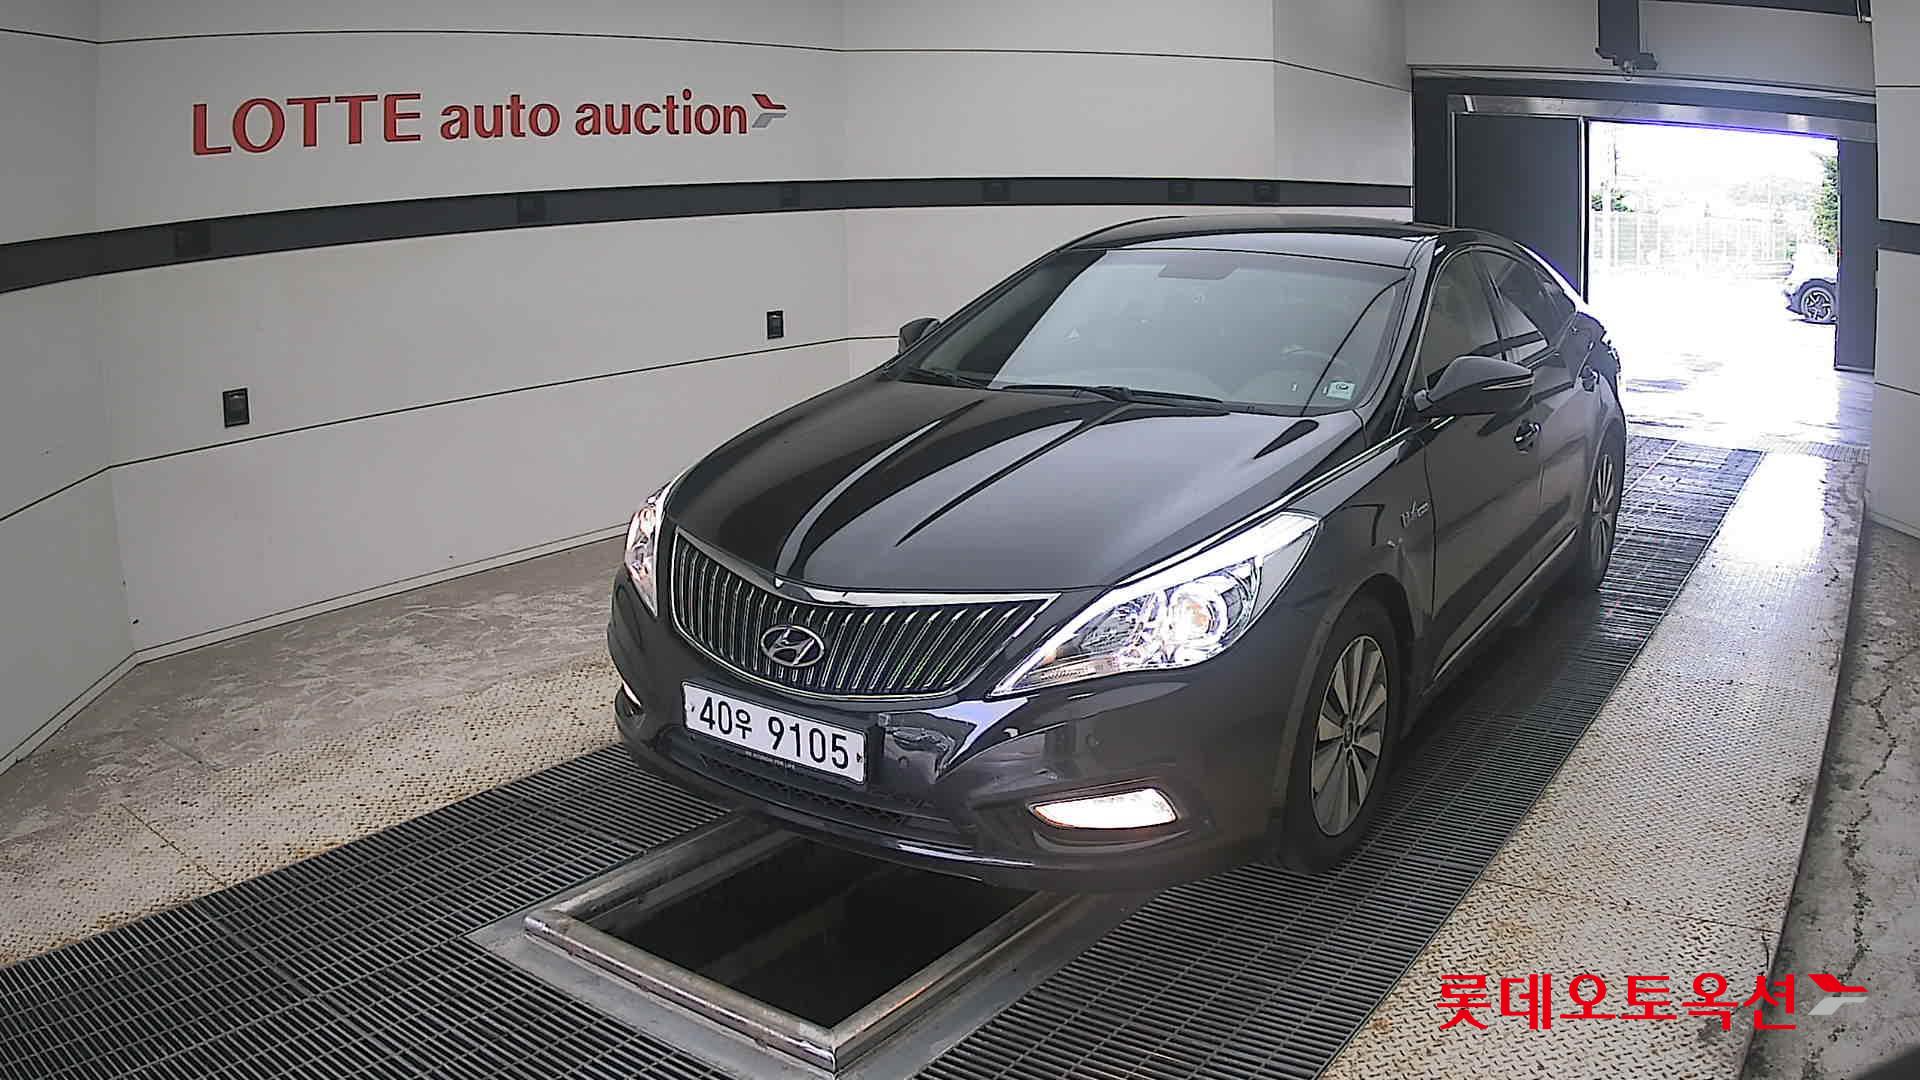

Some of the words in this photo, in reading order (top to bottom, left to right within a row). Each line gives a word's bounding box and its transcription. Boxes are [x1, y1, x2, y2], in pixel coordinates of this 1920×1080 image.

[193, 92, 422, 156] LOTTE
[440, 94, 561, 140] auto
[575, 88, 748, 136] auction
[700, 697, 752, 739] 40우
[768, 716, 848, 769] 9105
